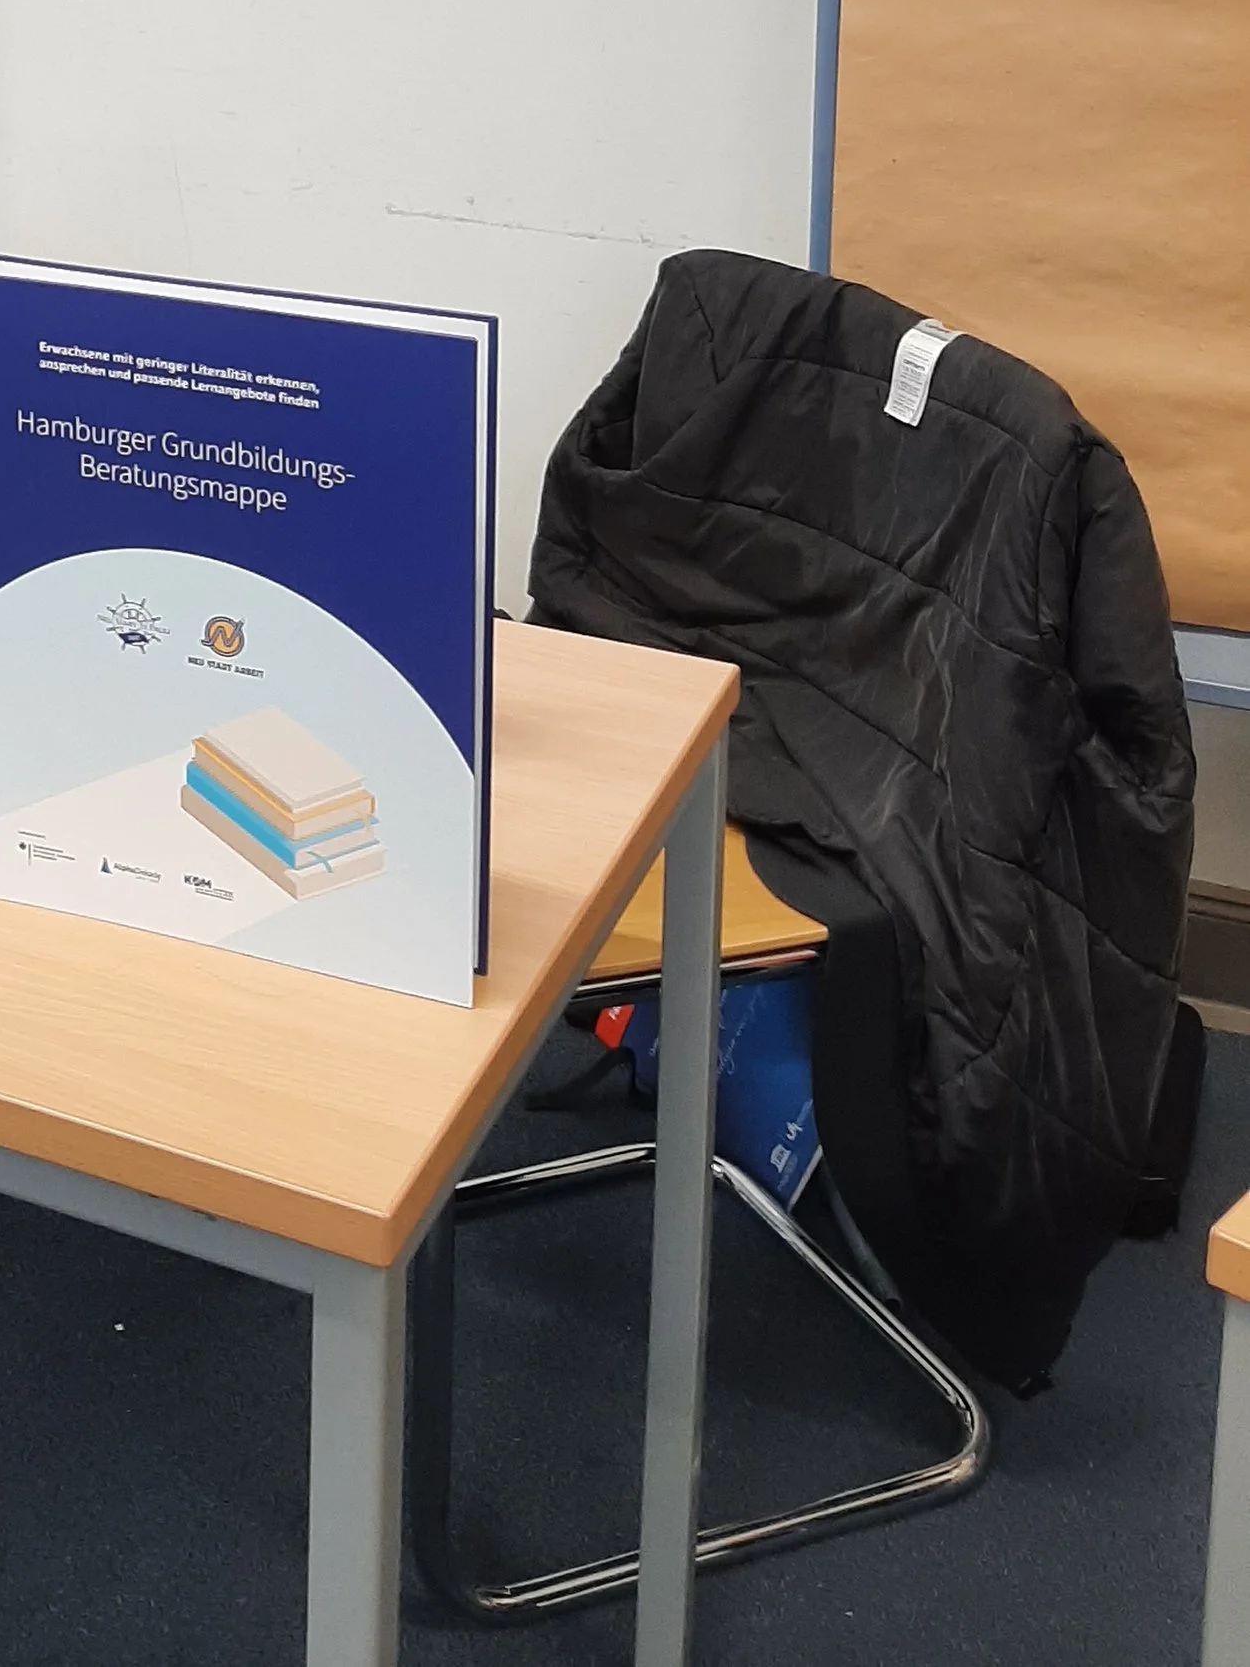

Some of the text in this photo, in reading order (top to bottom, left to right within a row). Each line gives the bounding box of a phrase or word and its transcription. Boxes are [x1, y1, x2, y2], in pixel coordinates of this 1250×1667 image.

[39, 341, 320, 394] Erwachsene mit geringer Literalität erkennen,
[39, 359, 320, 409] ansprechen und passende Lernangebote finden
[17, 410, 356, 489] Hamburger Grundbildungs-
[80, 454, 288, 513] Beratungsmappe
